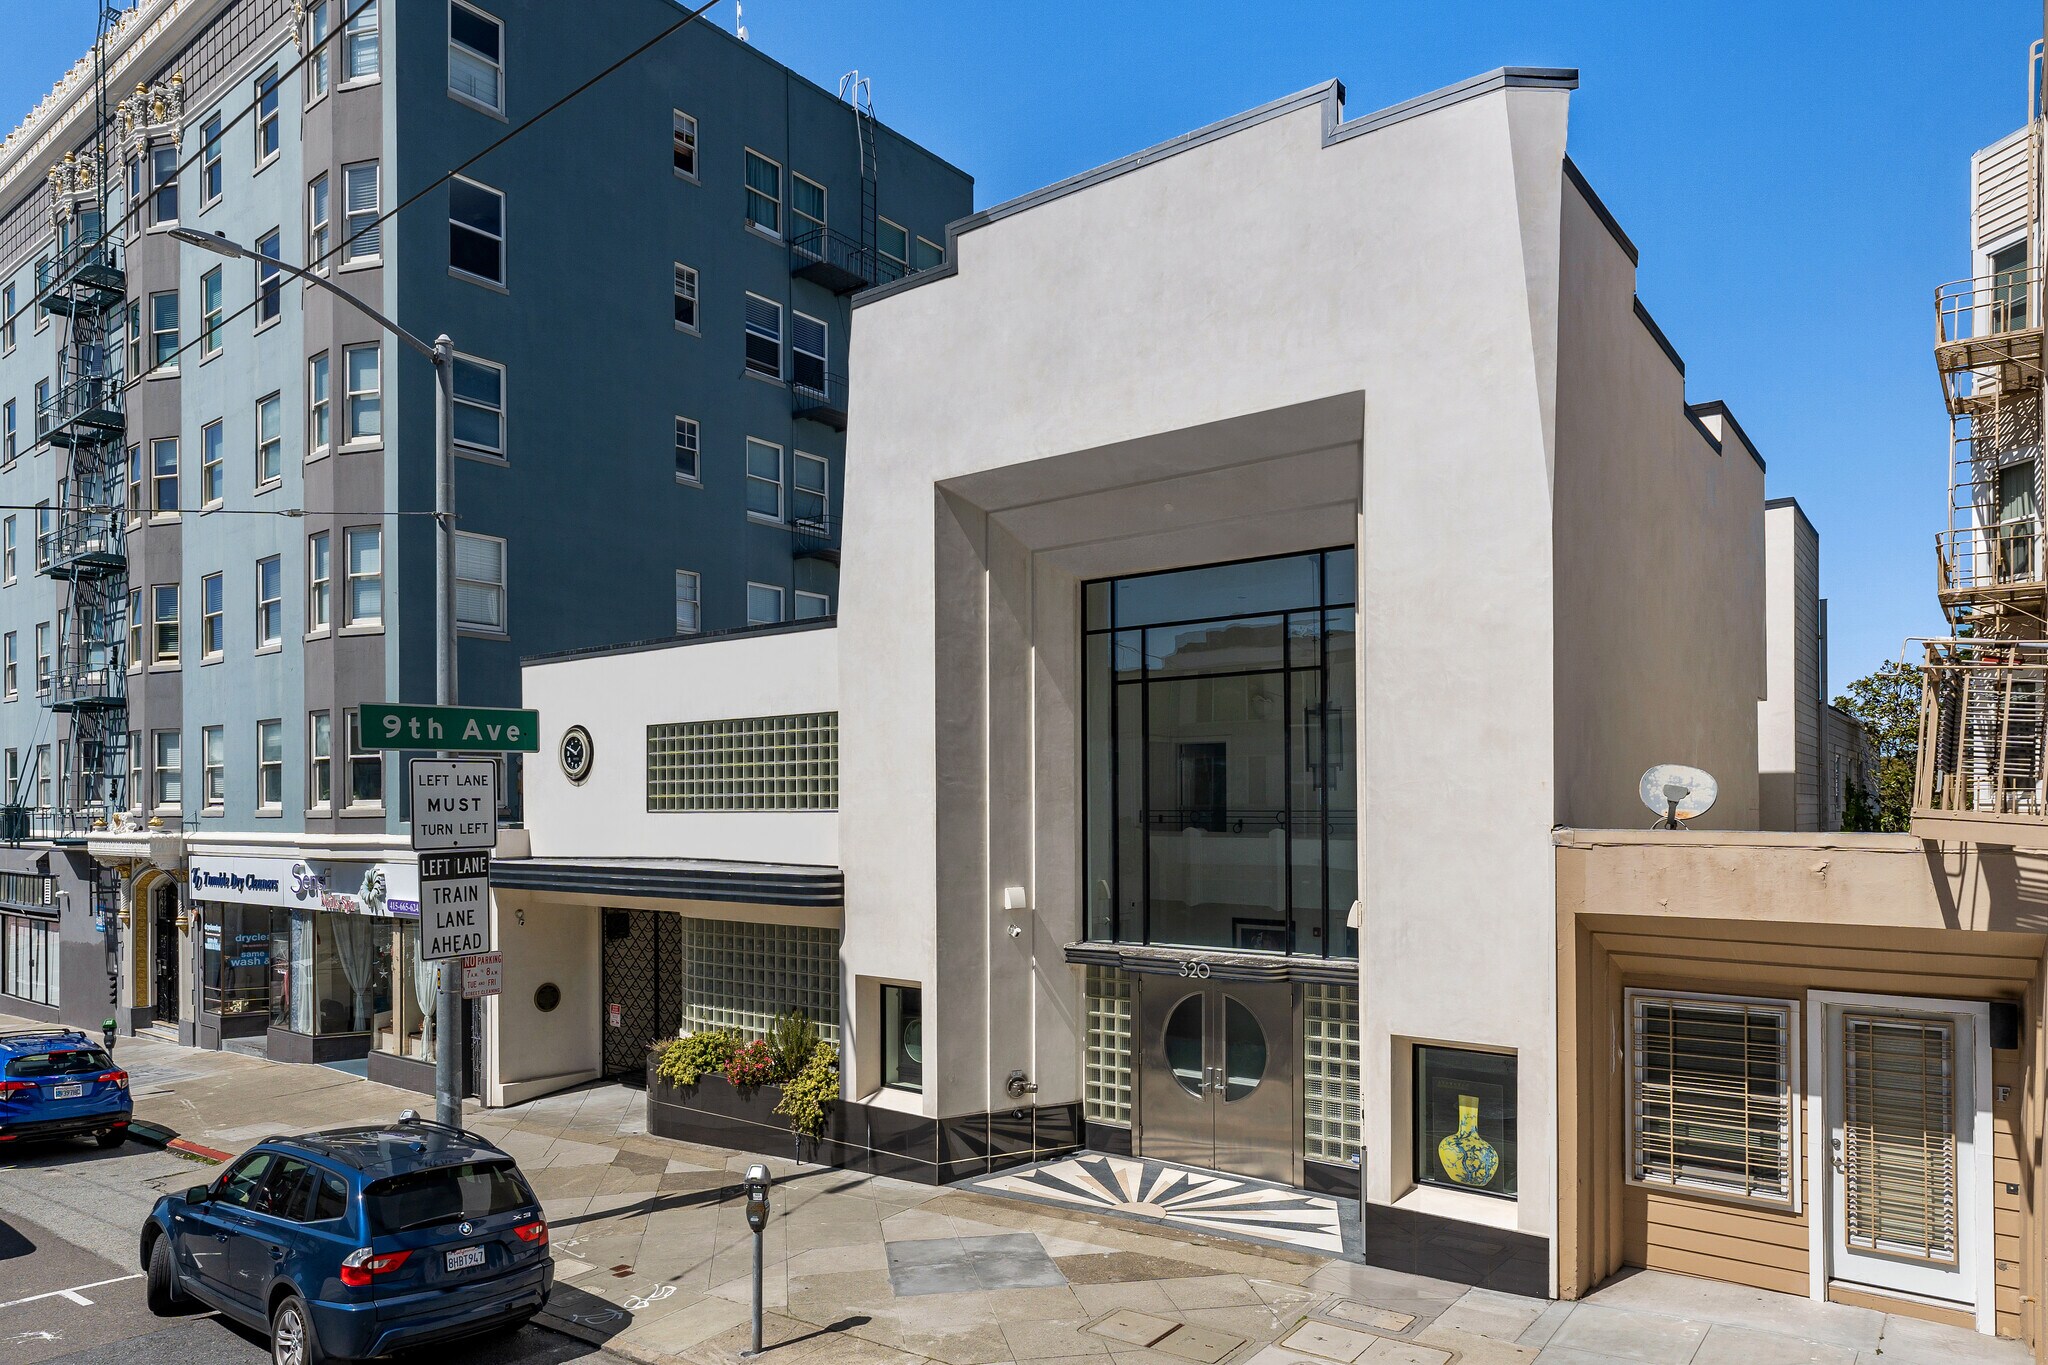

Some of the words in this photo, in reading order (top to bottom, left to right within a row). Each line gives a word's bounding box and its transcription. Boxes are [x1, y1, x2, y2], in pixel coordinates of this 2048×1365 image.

[382, 714, 443, 740] 9th
[462, 718, 520, 742] Ave
[419, 774, 449, 786] LEFT
[456, 774, 488, 786] LANE
[427, 797, 481, 812] MUST
[421, 824, 453, 836] TURN
[460, 823, 488, 835] LEFT
[422, 858, 450, 876] LEFT
[457, 856, 487, 874] LANE
[230, 873, 244, 894] Dry
[246, 874, 279, 892] Cleaners
[433, 885, 478, 904] TRAIN
[436, 909, 475, 929] LANE
[431, 933, 481, 954] AHEAD
[231, 957, 261, 967] wash
[241, 950, 265, 958] same
[464, 956, 476, 967] NO
[477, 955, 502, 965] PARKING
[1179, 961, 1210, 979] 320
[487, 978, 497, 986] FRI
[448, 1251, 483, 1269] 8HBT947
